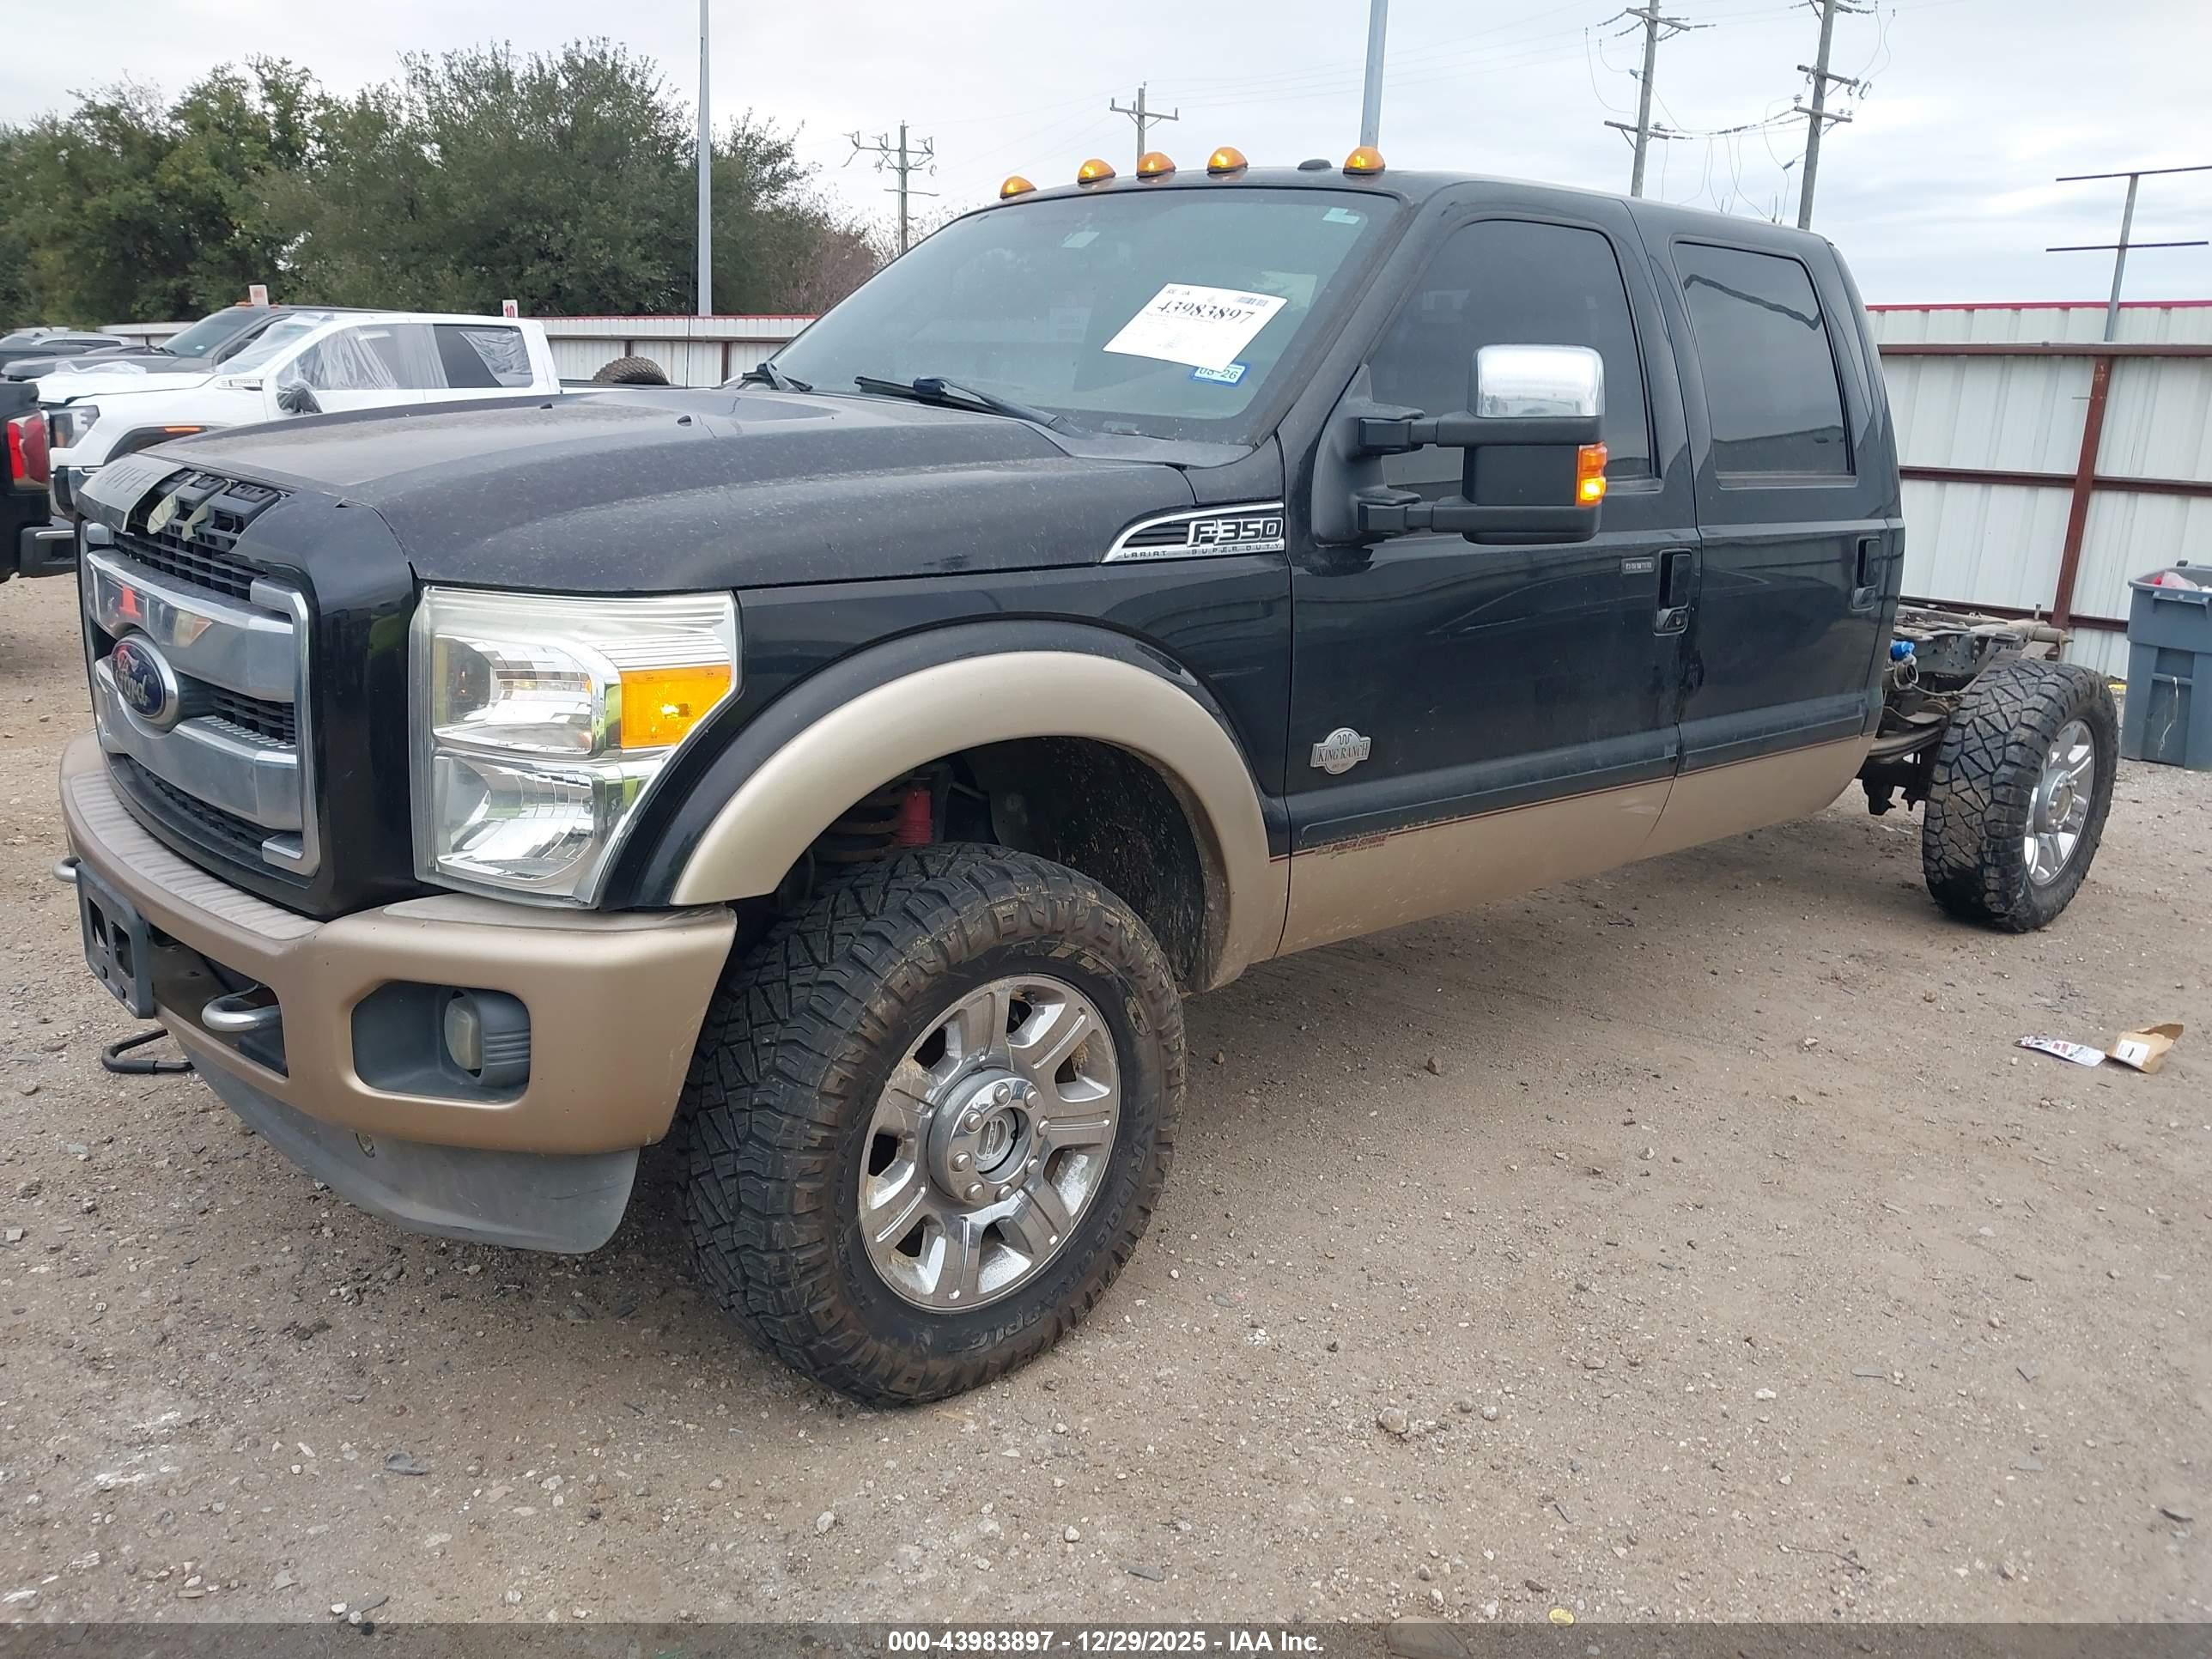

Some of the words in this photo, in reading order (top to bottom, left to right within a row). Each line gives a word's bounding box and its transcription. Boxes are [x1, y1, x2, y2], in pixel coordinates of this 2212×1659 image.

[1157, 301, 1255, 324] 43983897
[1188, 518, 1284, 545] F-350
[1191, 546, 1238, 556] SUPER
[1245, 542, 1280, 551] DUTY
[115, 649, 148, 706] Ford
[1318, 748, 1340, 763] KING
[1341, 742, 1368, 759] RANCH
